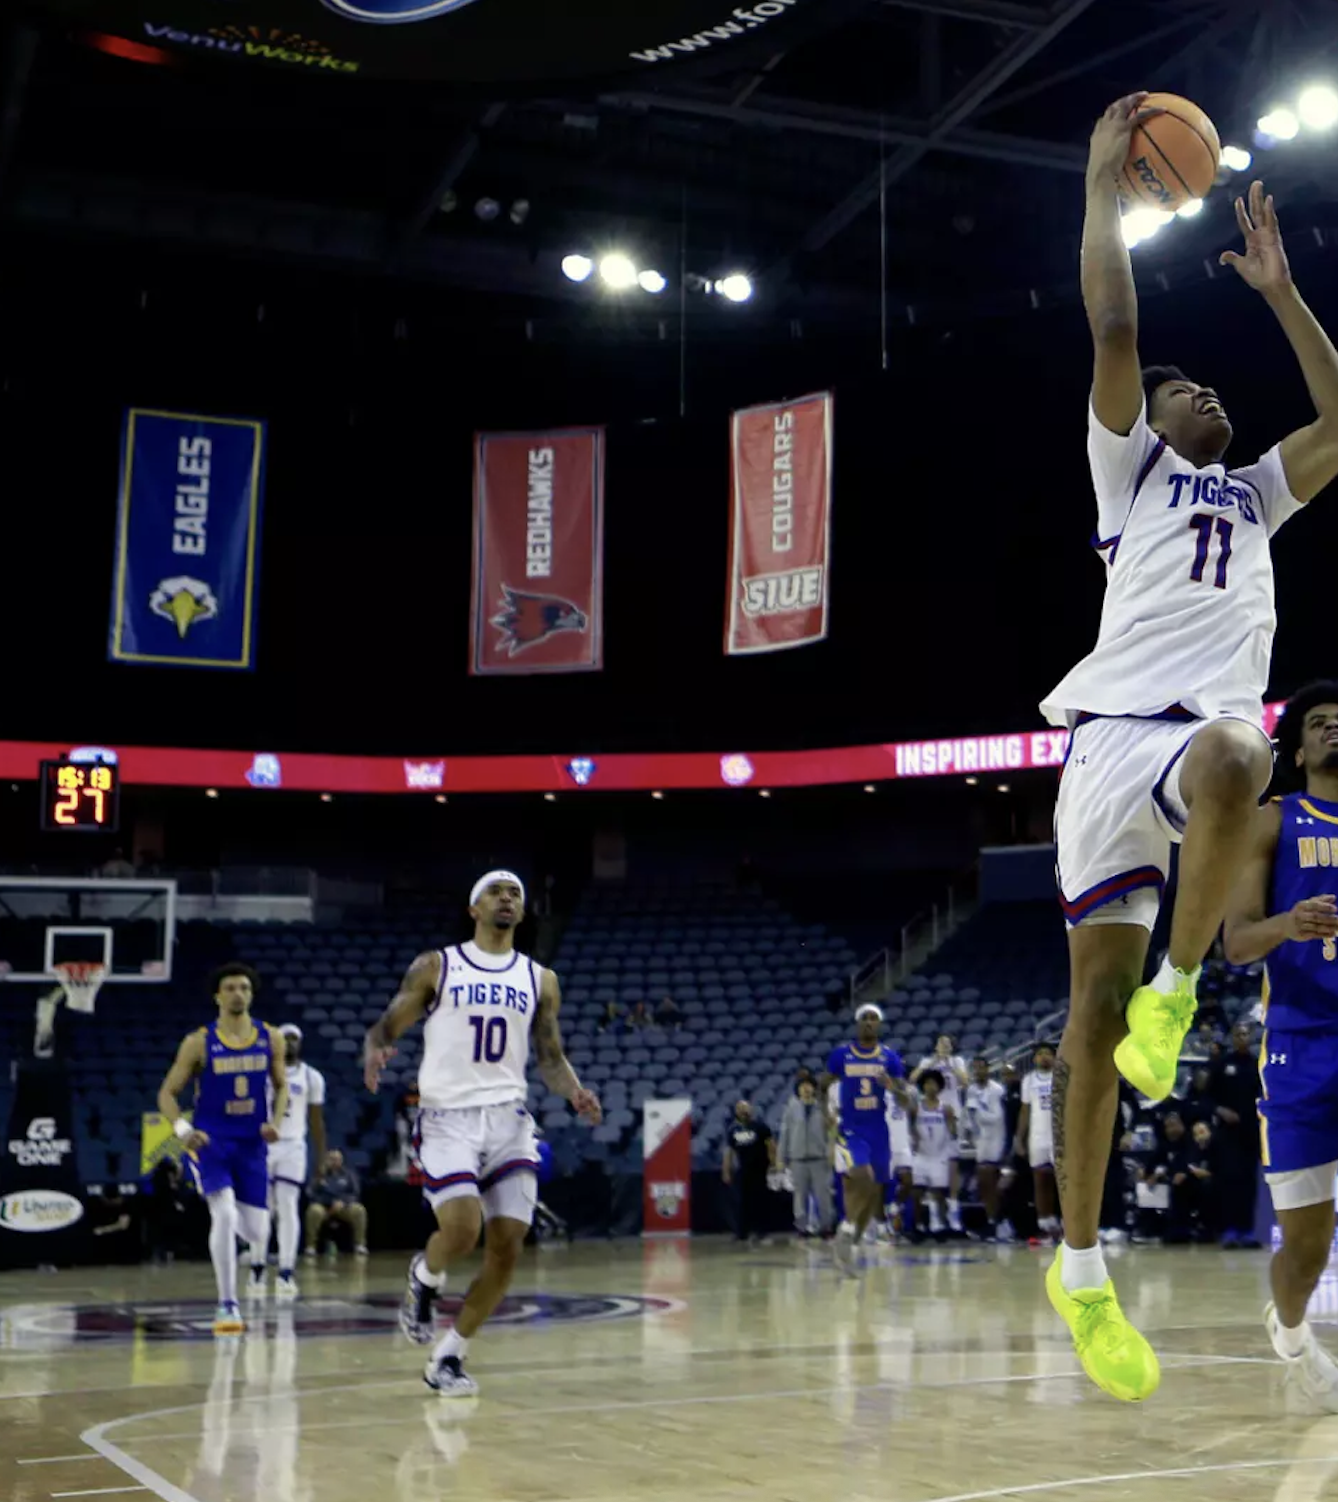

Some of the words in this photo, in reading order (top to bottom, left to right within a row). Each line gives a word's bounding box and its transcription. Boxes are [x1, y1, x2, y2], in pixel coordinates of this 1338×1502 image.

[144, 22, 360, 72] VenuWorks
[172, 436, 212, 556] EAGLES
[772, 411, 793, 553] COUGARS
[526, 447, 555, 578] REDHAWKS
[1188, 512, 1234, 589] 11
[744, 568, 821, 613] SIUE
[895, 735, 1023, 776] INSPIRING
[1031, 731, 1070, 767] EX
[55, 788, 104, 824] 27
[449, 983, 528, 1015] TIGERS
[468, 1015, 507, 1063] 10
[8, 1139, 71, 1154] GAME
[17, 1151, 62, 1167] ONE
